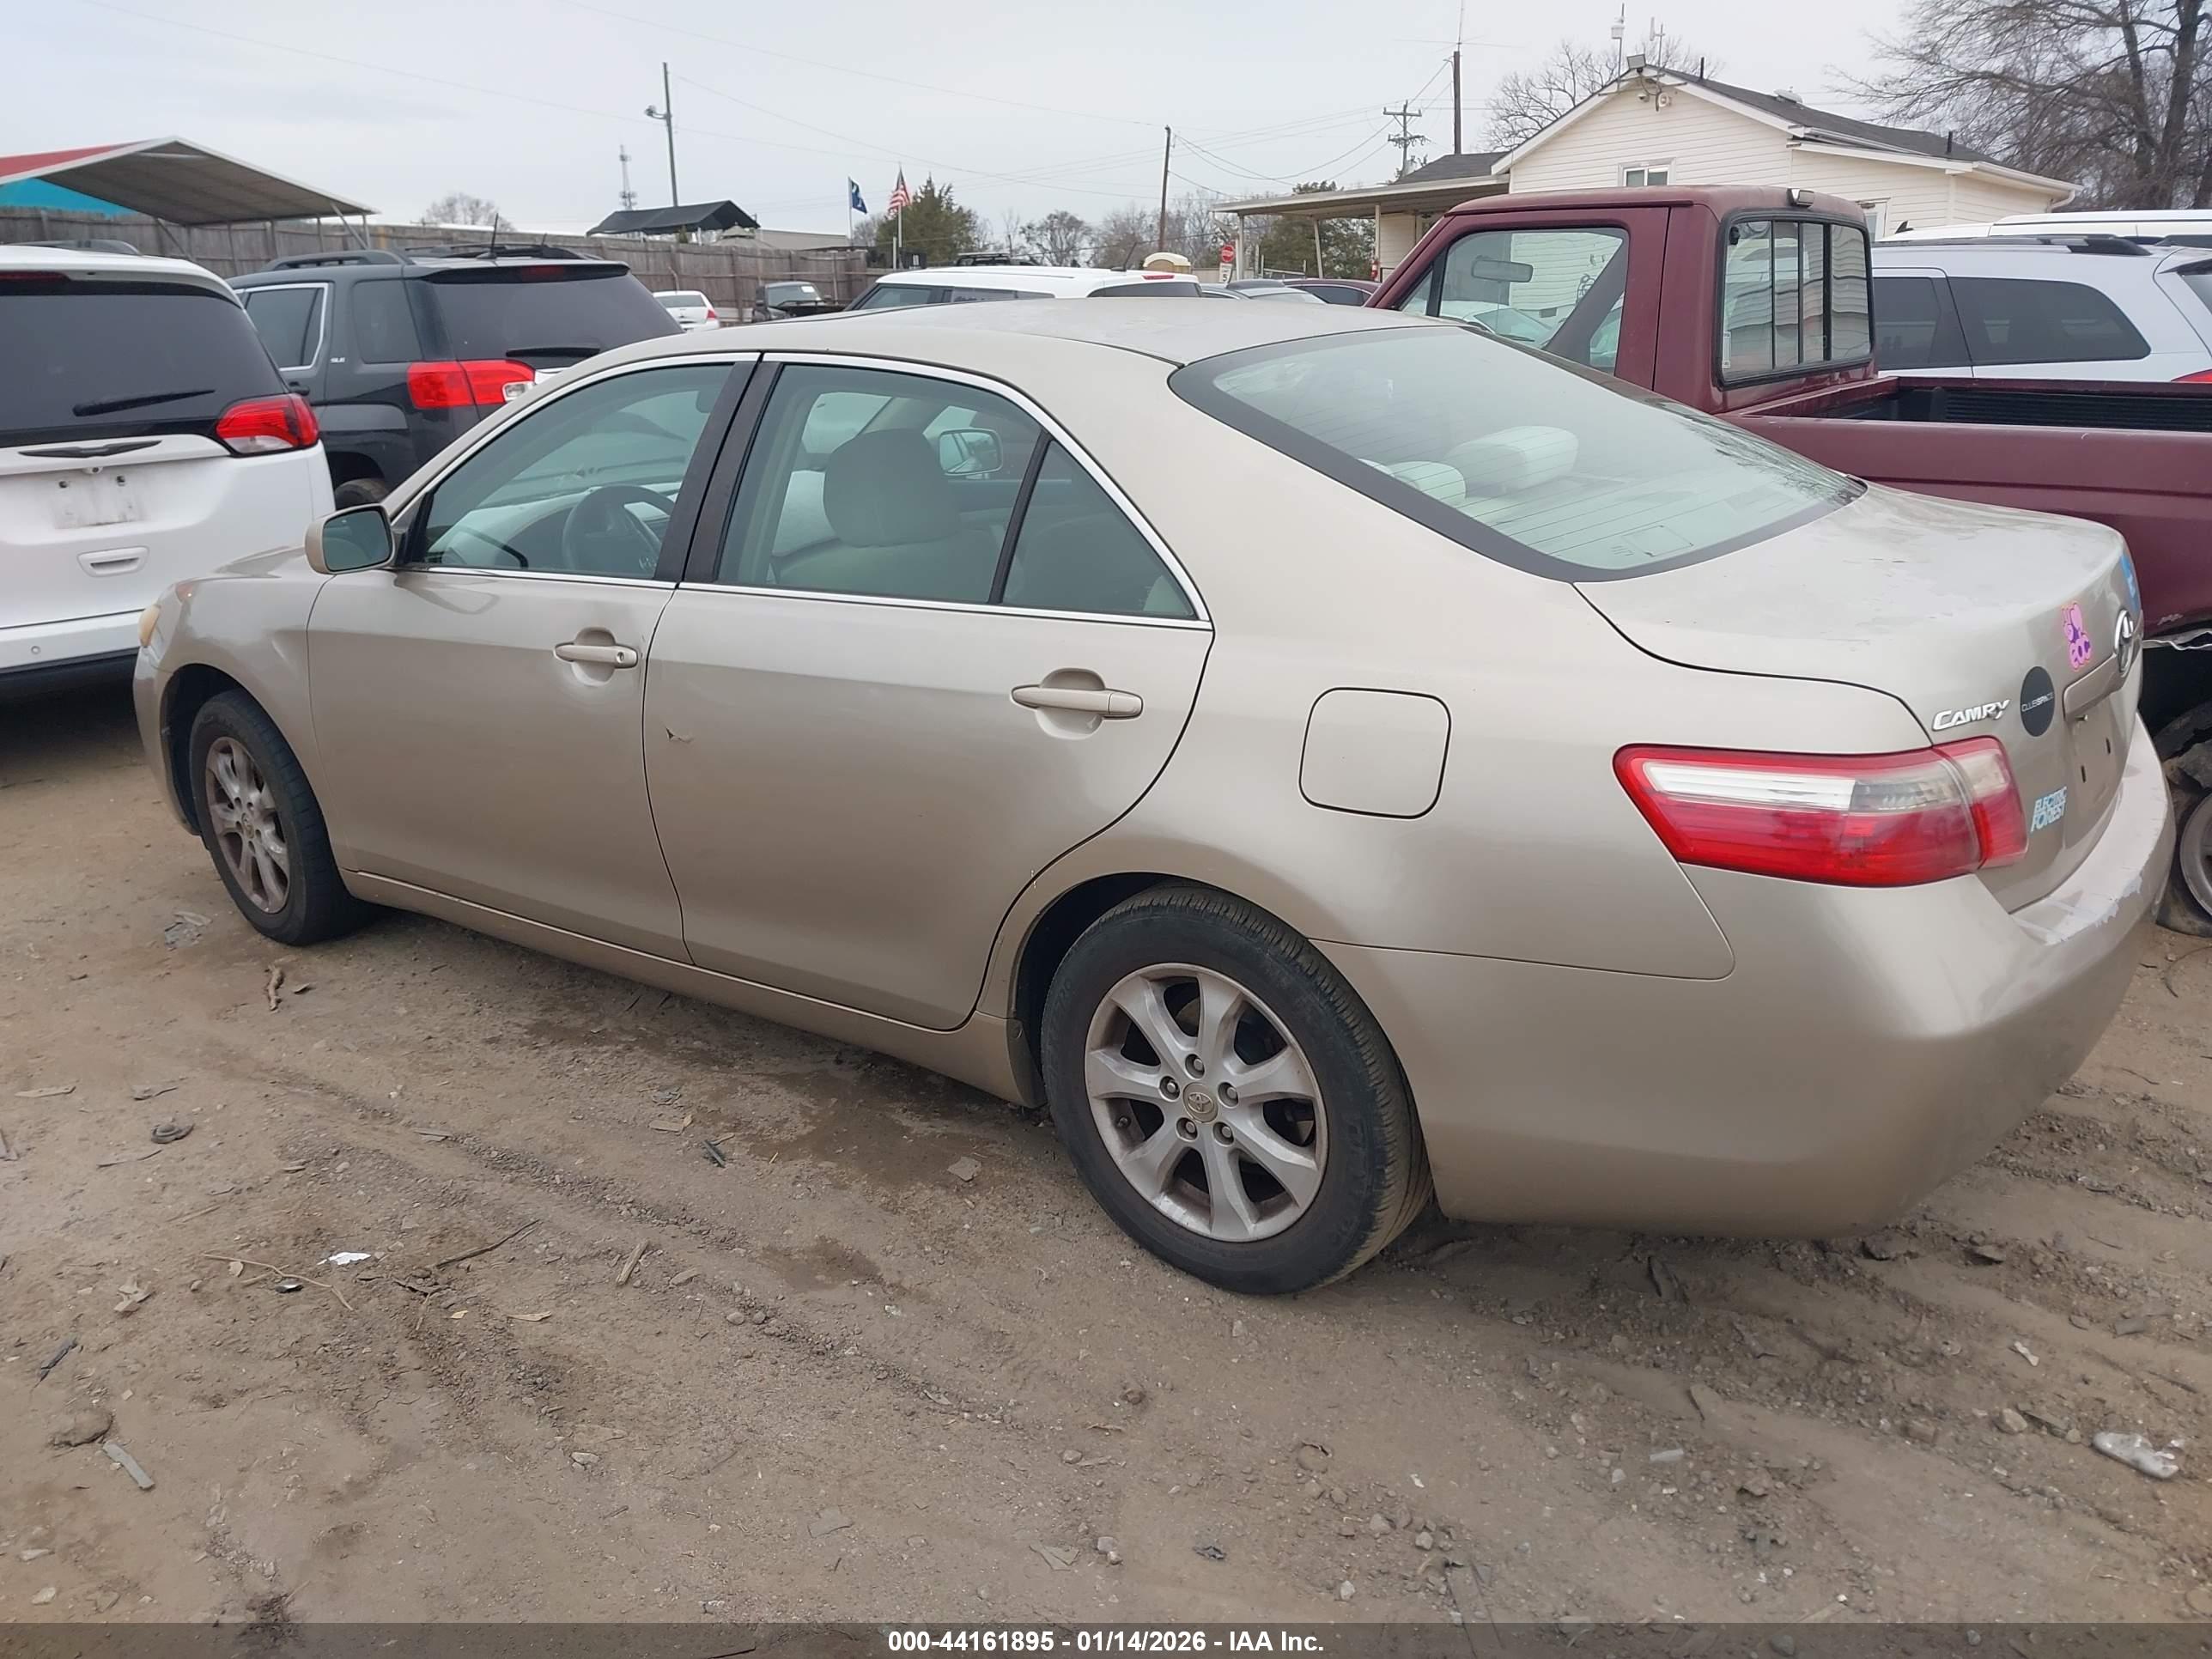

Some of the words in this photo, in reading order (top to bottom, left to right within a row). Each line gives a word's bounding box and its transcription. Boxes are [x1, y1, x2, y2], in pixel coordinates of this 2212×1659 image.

[1932, 699, 2010, 732] CAMRY
[2034, 786, 2067, 813] ELECTRIC
[2031, 802, 2066, 833] FOREST
